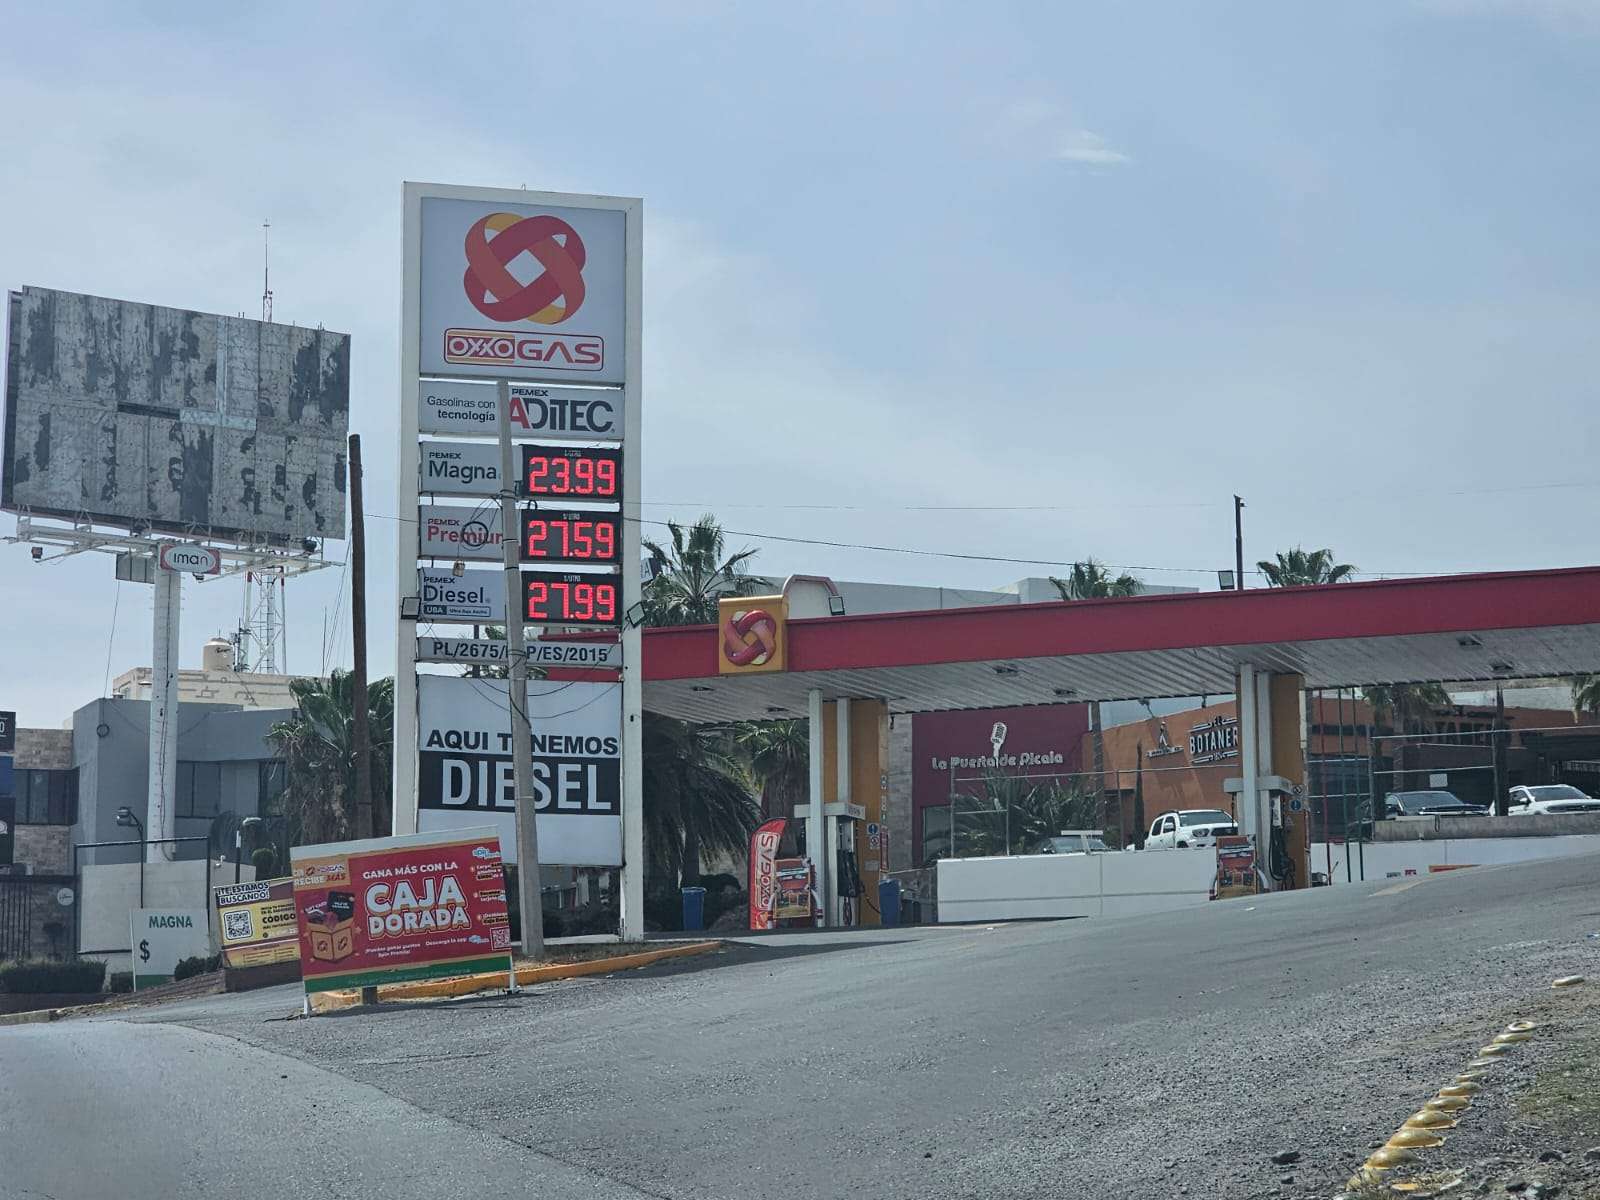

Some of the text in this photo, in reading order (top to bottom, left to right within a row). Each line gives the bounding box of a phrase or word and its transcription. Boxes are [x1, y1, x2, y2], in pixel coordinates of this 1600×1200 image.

[427, 396, 495, 409] Gasolinas con
[512, 388, 549, 396] PEMEX
[429, 452, 461, 460] PEMEX
[429, 460, 497, 484] Magna
[529, 456, 616, 495] 23.99
[427, 518, 460, 526] PEMEX
[528, 520, 615, 558] 27.59
[423, 585, 484, 603] Diesel
[528, 582, 616, 621] 27.99
[426, 729, 618, 755] AQUI TNEMOS
[442, 758, 612, 811] DIESEL
[363, 861, 459, 880] GANA MÁS CON LA
[232, 881, 269, 893] ESTAMOS
[366, 876, 465, 915] CAJA
[149, 915, 193, 928] MAGNA
[369, 906, 471, 938] DORADA
[139, 938, 150, 963] $
